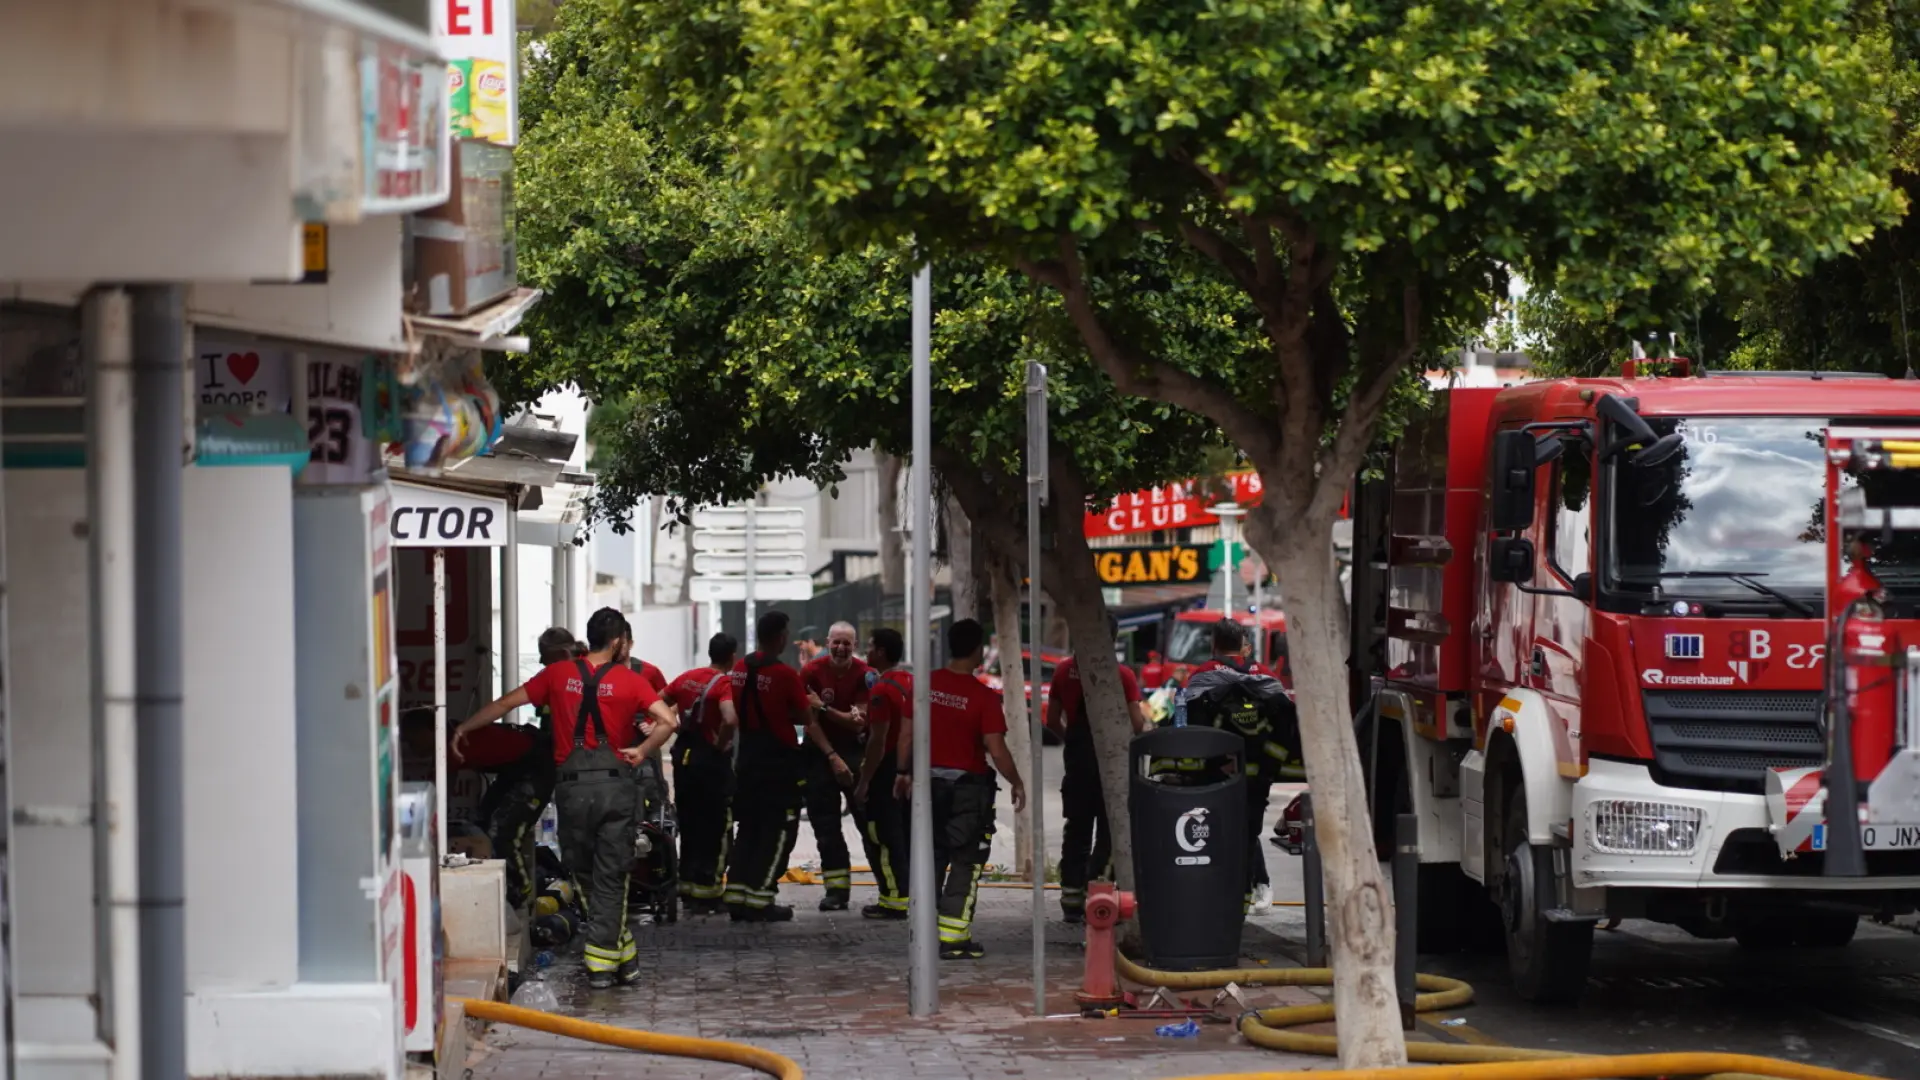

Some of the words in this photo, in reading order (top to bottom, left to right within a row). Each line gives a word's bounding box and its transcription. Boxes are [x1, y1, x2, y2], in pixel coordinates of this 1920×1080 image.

[308, 405, 351, 464] 23
[390, 506, 494, 540] CTOR
[1107, 502, 1188, 531] CLUB
[1095, 545, 1199, 583] GAN'S
[1665, 672, 1735, 685] rosenbauer
